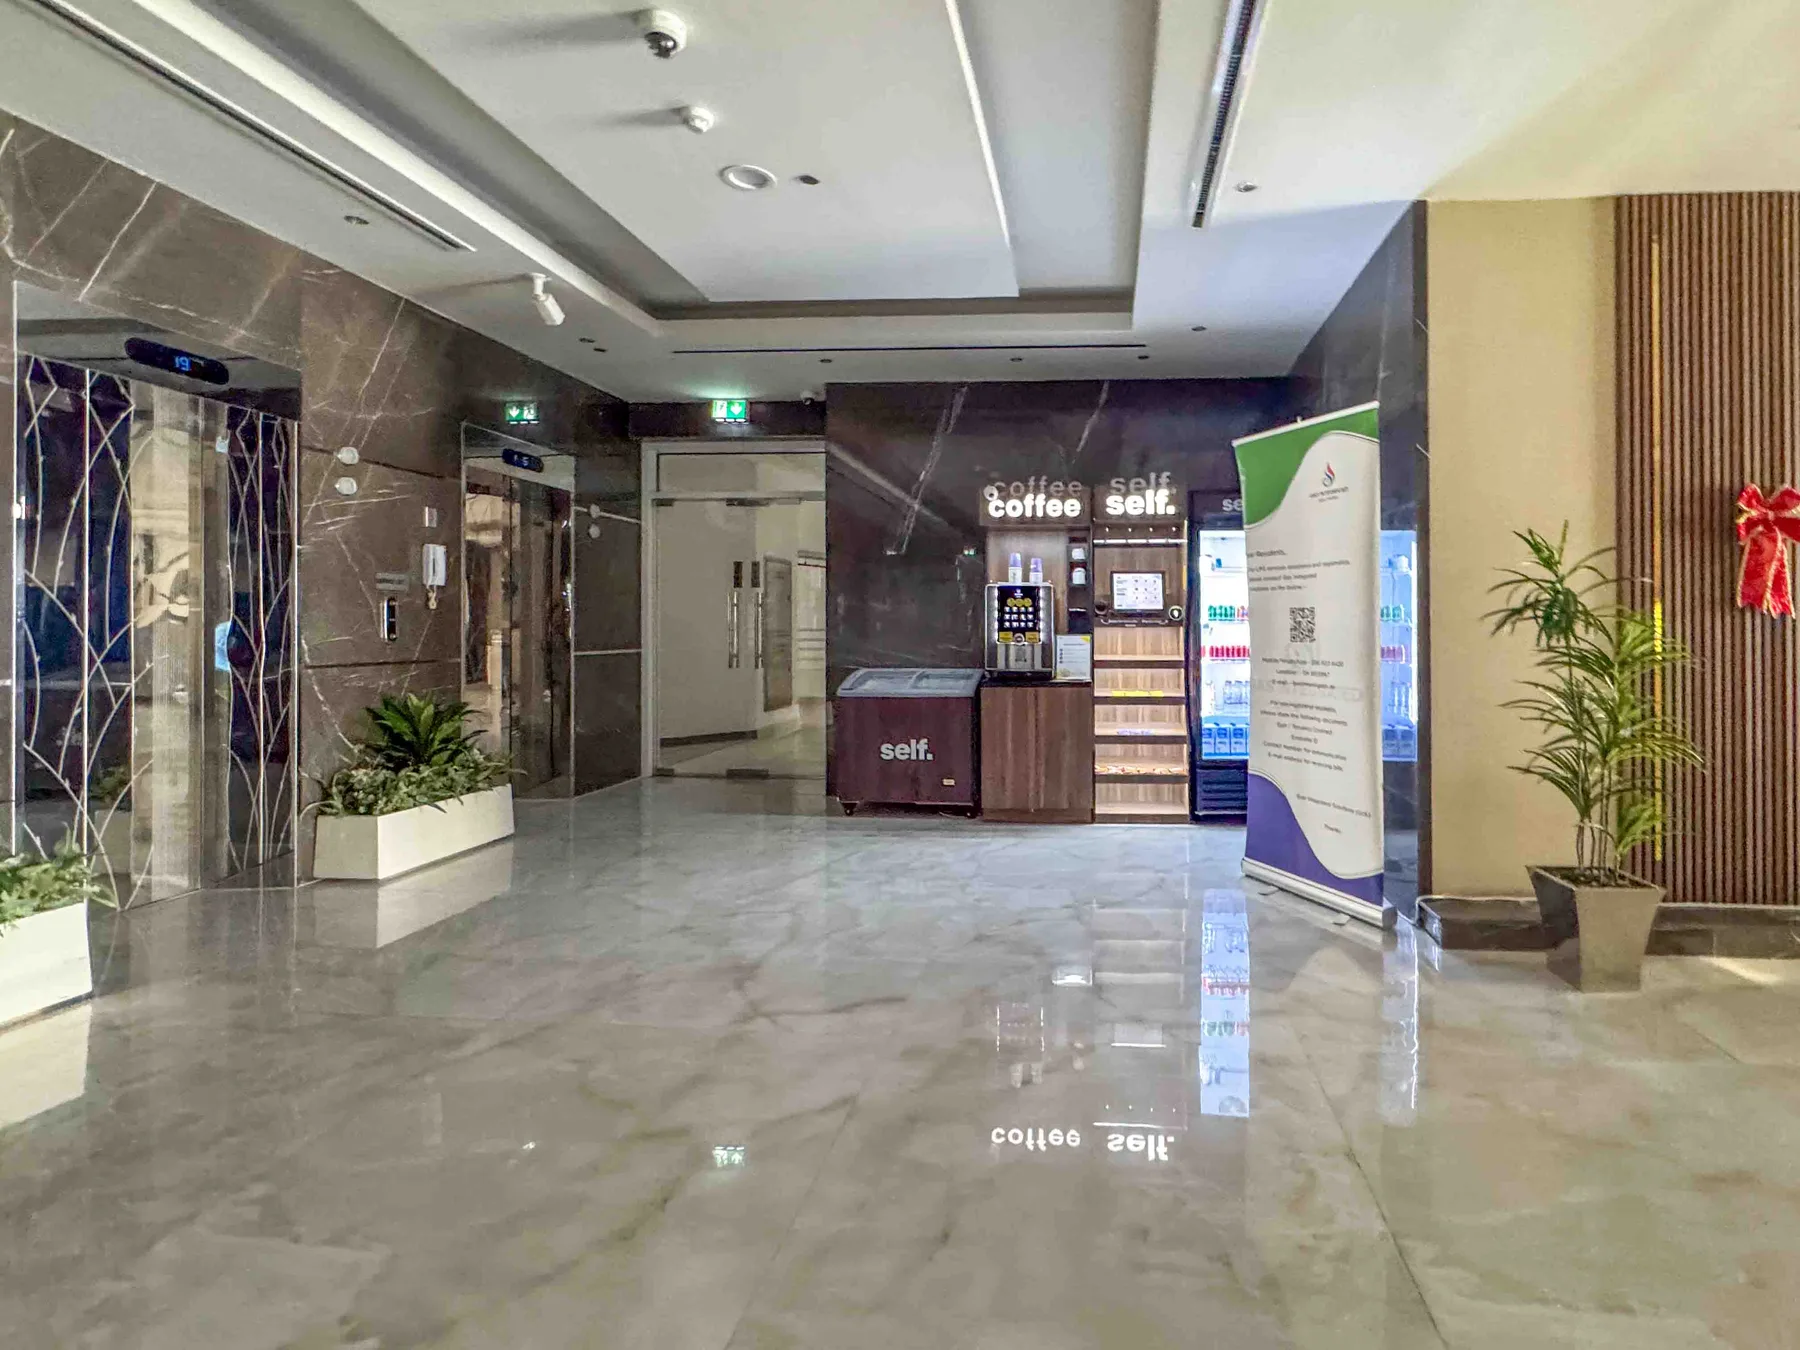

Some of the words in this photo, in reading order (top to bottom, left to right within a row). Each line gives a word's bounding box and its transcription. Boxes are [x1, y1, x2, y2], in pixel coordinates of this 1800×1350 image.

[174, 356, 190, 371] 19
[988, 493, 1081, 518] coffee
[1105, 488, 1176, 515] self.
[1222, 498, 1242, 512] se
[880, 738, 934, 760] self.
